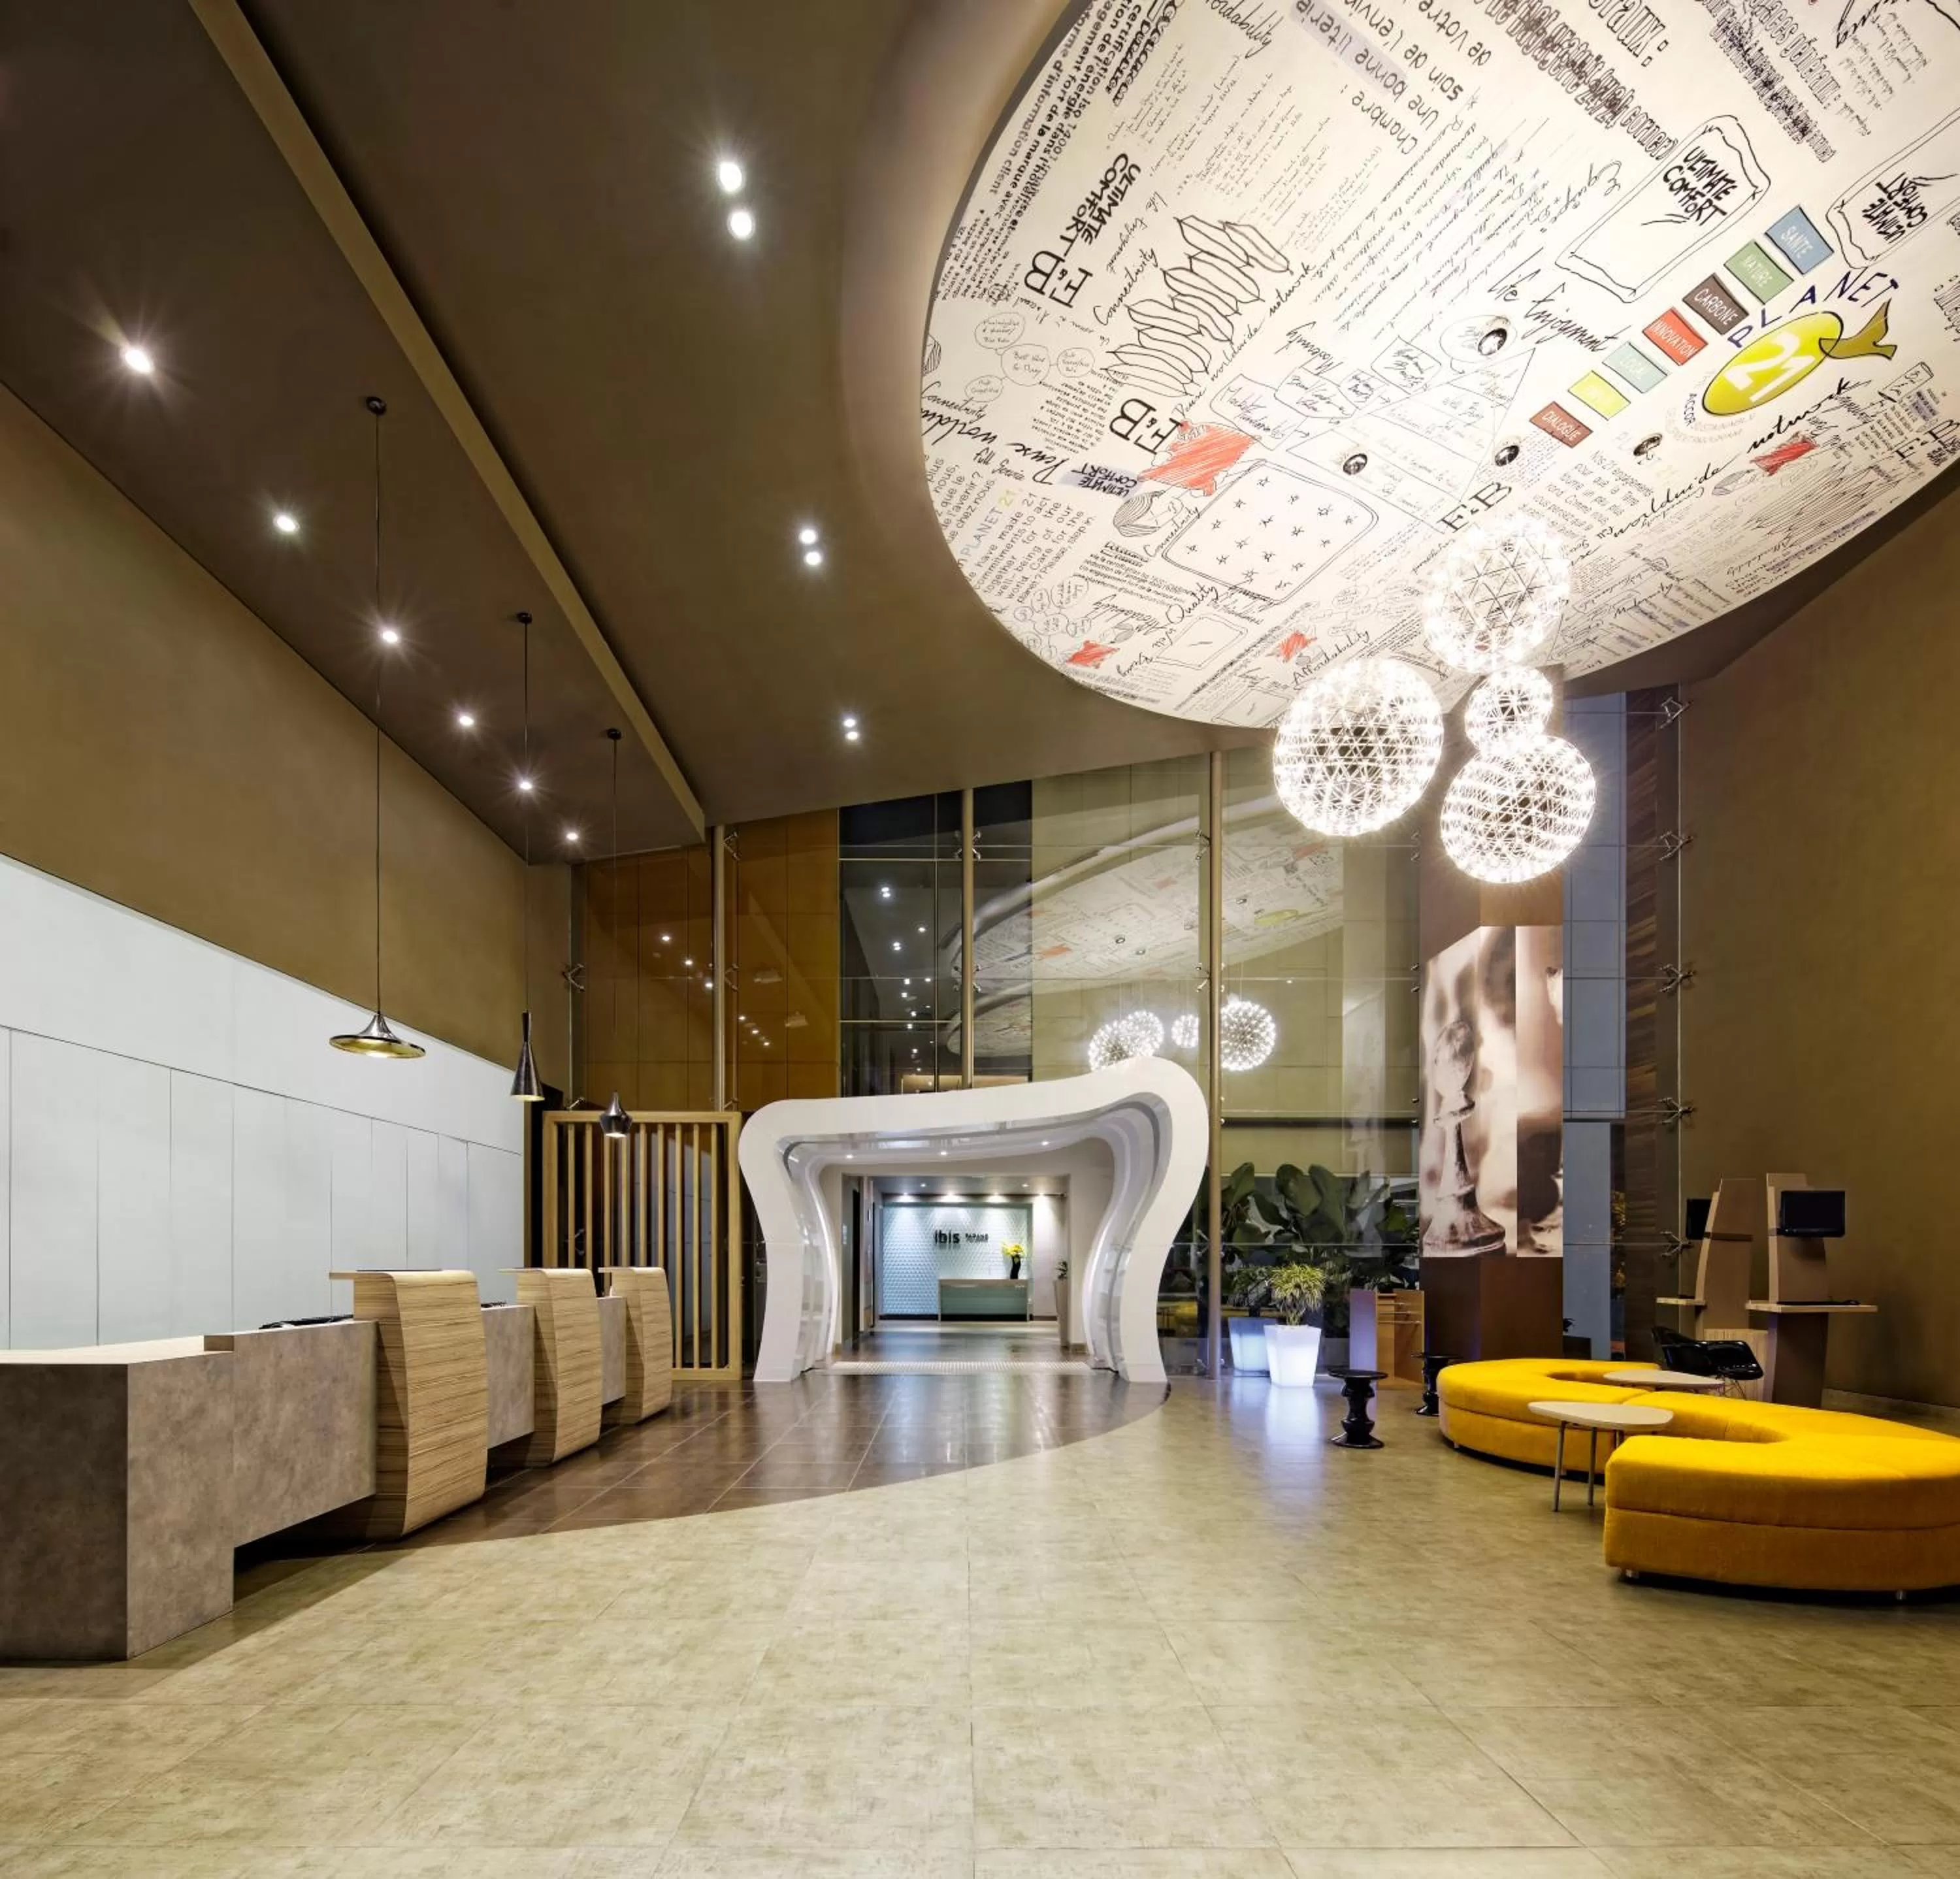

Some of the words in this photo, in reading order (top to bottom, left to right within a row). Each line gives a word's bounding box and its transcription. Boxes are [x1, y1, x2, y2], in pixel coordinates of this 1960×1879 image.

[1403, 44, 1428, 69] de
[1467, 41, 1492, 66] de
[1056, 74, 1077, 103] fort
[1354, 48, 1407, 103] bonne
[1428, 66, 1463, 101] soin
[1046, 104, 1058, 122] de
[1351, 90, 1418, 155] Chambre
[1407, 94, 1439, 131] Une
[1009, 139, 1039, 189] marque
[1683, 146, 1739, 202] ULTIMATE
[1059, 153, 1128, 257] COMFORT
[1080, 157, 1141, 245] ULTIMATE
[1663, 165, 1728, 226] COMFORT
[1521, 282, 1631, 352] Enjoyment
[1694, 285, 1739, 327] CARBONE
[1727, 270, 1901, 348] PLANET
[1651, 319, 1696, 357] INNOVATION
[1541, 410, 1582, 441] DIALOGUE
[1071, 463, 1137, 488] COMFORT
[1165, 582, 1218, 624] Quality
